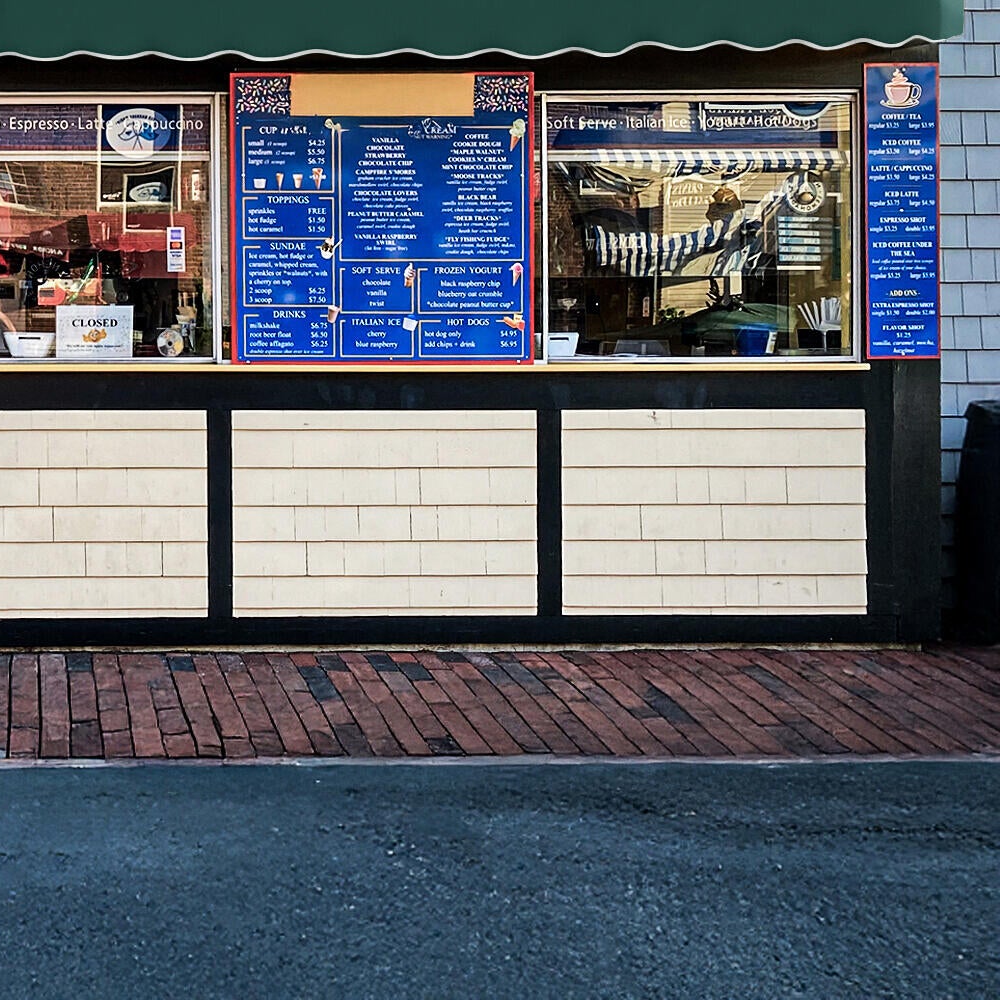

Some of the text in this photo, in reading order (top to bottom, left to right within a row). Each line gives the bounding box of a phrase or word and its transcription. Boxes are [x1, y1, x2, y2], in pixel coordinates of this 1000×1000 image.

[10, 117, 68, 132] Espresso
[547, 116, 575, 129] Soft
[580, 116, 617, 129] Serve
[626, 116, 666, 128] Italian
[670, 116, 687, 128] Ice
[259, 126, 277, 134] CUP
[270, 242, 306, 250] SUNDAE
[487, 280, 500, 288] chip
[72, 319, 118, 327] CLOSED
[370, 341, 397, 349] raspberry
